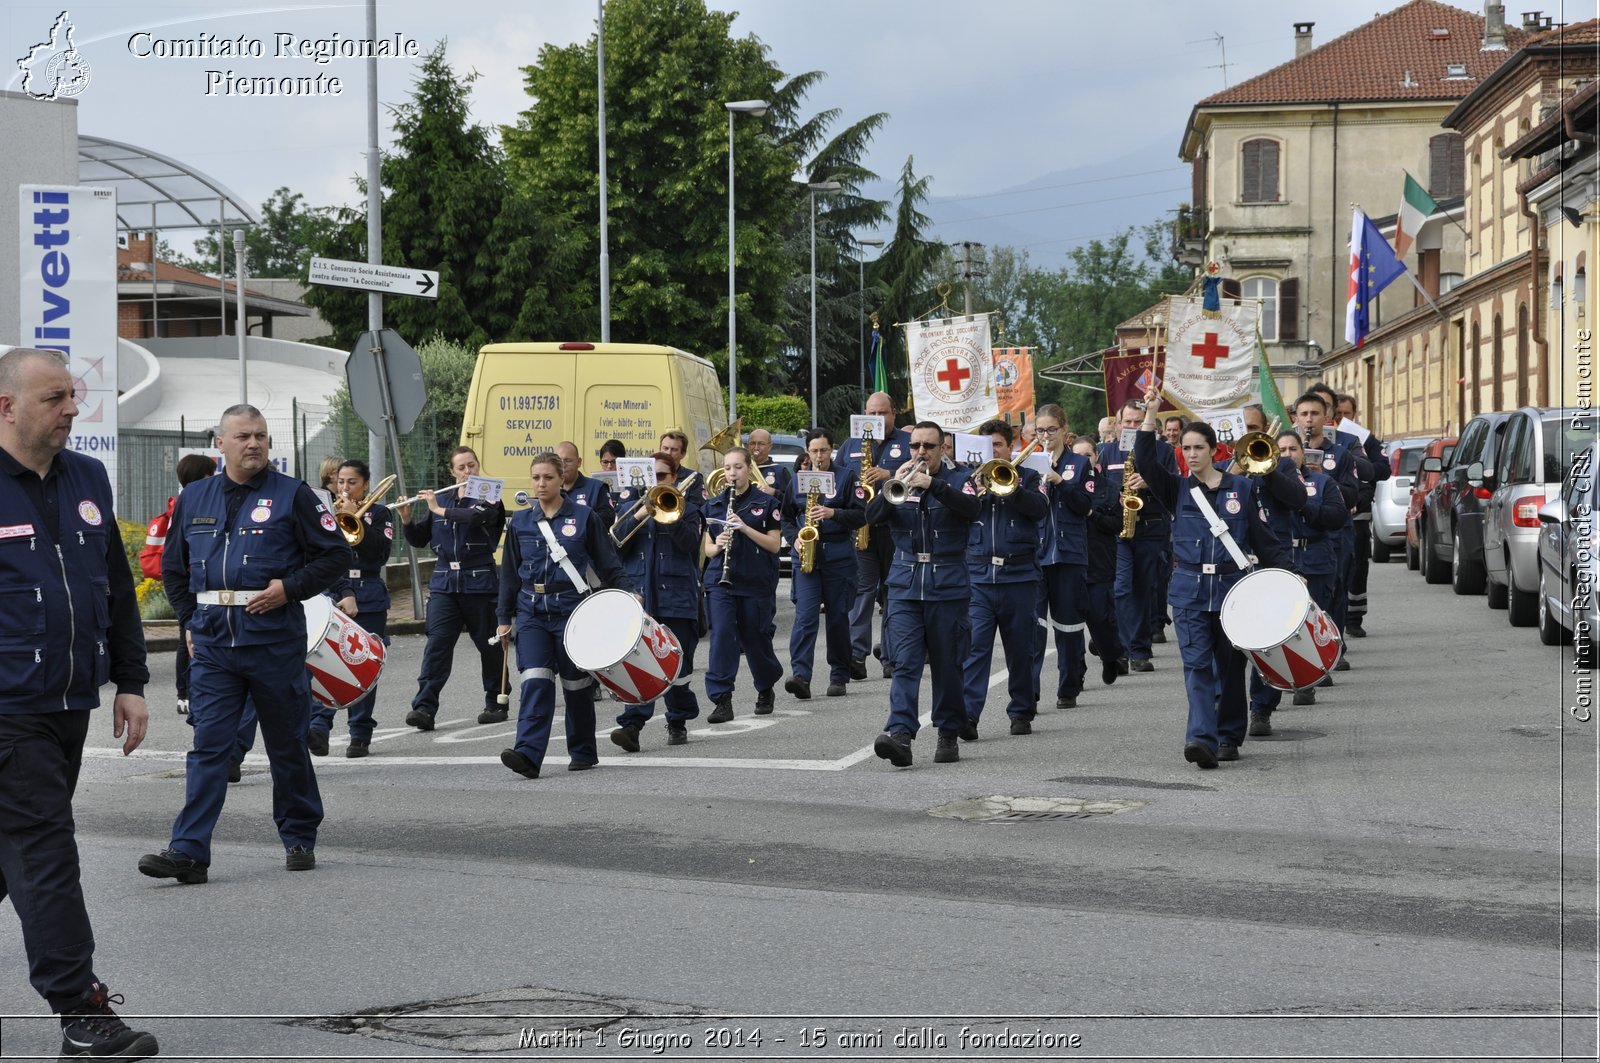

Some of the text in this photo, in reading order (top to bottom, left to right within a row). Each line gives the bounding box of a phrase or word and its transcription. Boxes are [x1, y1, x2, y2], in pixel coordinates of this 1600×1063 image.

[312, 262, 411, 280] C.I.S. Consorzio Socio Assistenziale
[331, 274, 348, 282] diurno
[1174, 319, 1195, 342] CROCE
[1224, 317, 1248, 346] ITALIANA
[914, 336, 990, 373] CROCE ROSSA ITALIANA
[941, 348, 969, 356] GINEVRA
[1169, 376, 1179, 390] SAN
[1177, 388, 1216, 406] FRANCESCO
[1229, 380, 1247, 399] CAMPO
[604, 400, 648, 410] Acque Minerali
[927, 406, 985, 418] COMITATO LOCALE
[506, 420, 552, 430] SERVIZIO
[603, 418, 613, 426] vini
[618, 418, 633, 427] bibite
[638, 418, 651, 427] birra
[944, 415, 972, 426] FIANO
[525, 433, 532, 443] A
[595, 429, 608, 439] latte
[613, 430, 633, 439] biscotti
